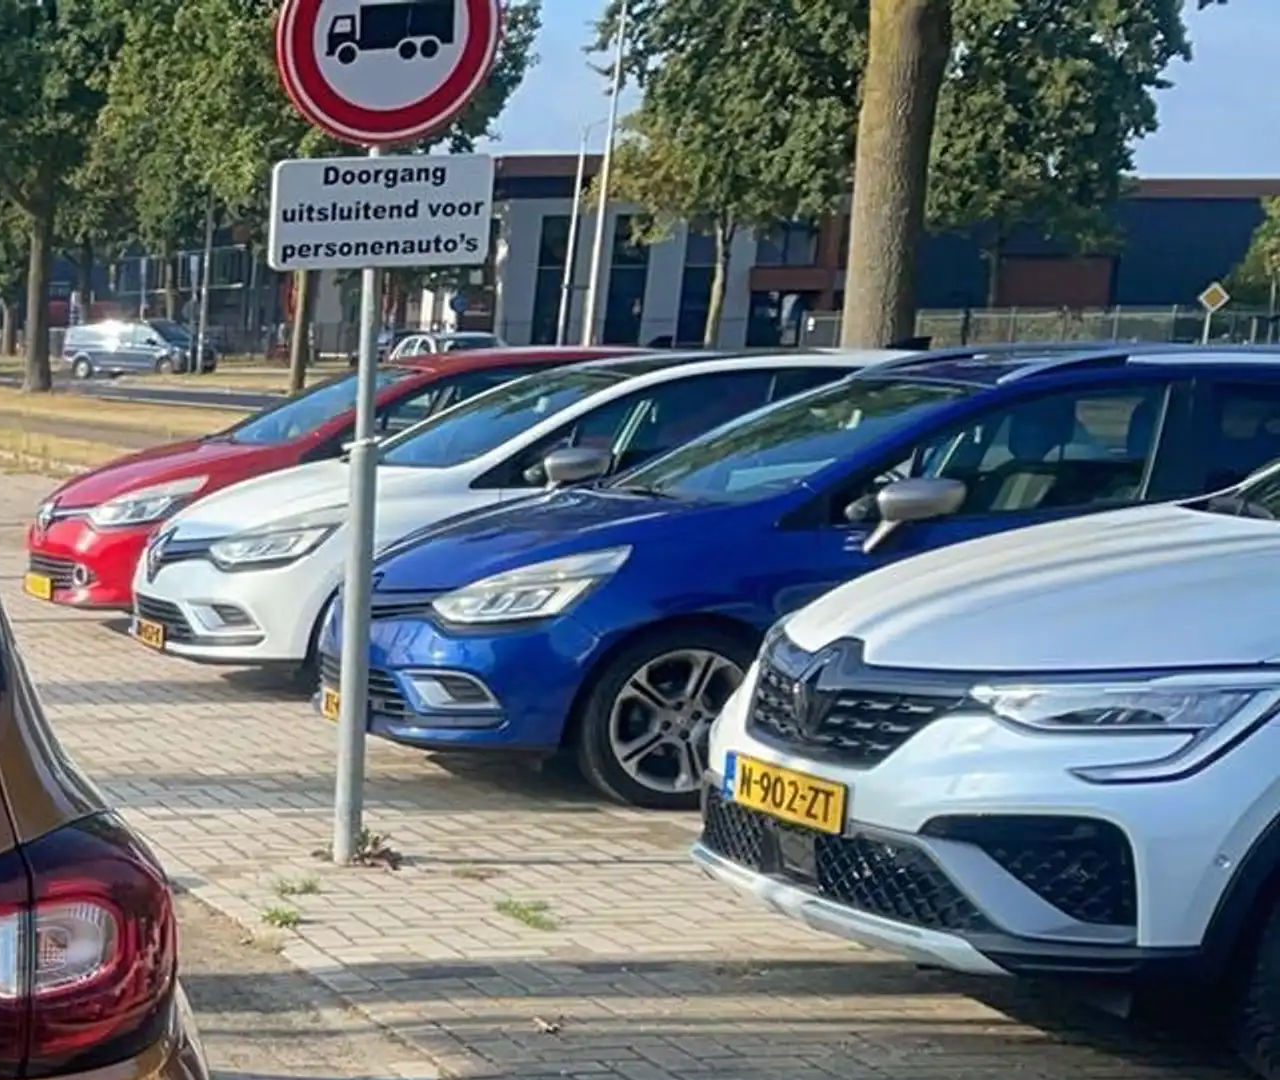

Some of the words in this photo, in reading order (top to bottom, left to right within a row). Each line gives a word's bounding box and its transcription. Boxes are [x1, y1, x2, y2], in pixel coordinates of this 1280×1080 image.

[323, 164, 446, 188] Doorgang
[281, 200, 419, 223] uitsluitend
[428, 201, 485, 218] voor
[281, 234, 479, 262] personenauto's
[740, 763, 835, 823] N-902-ZT
